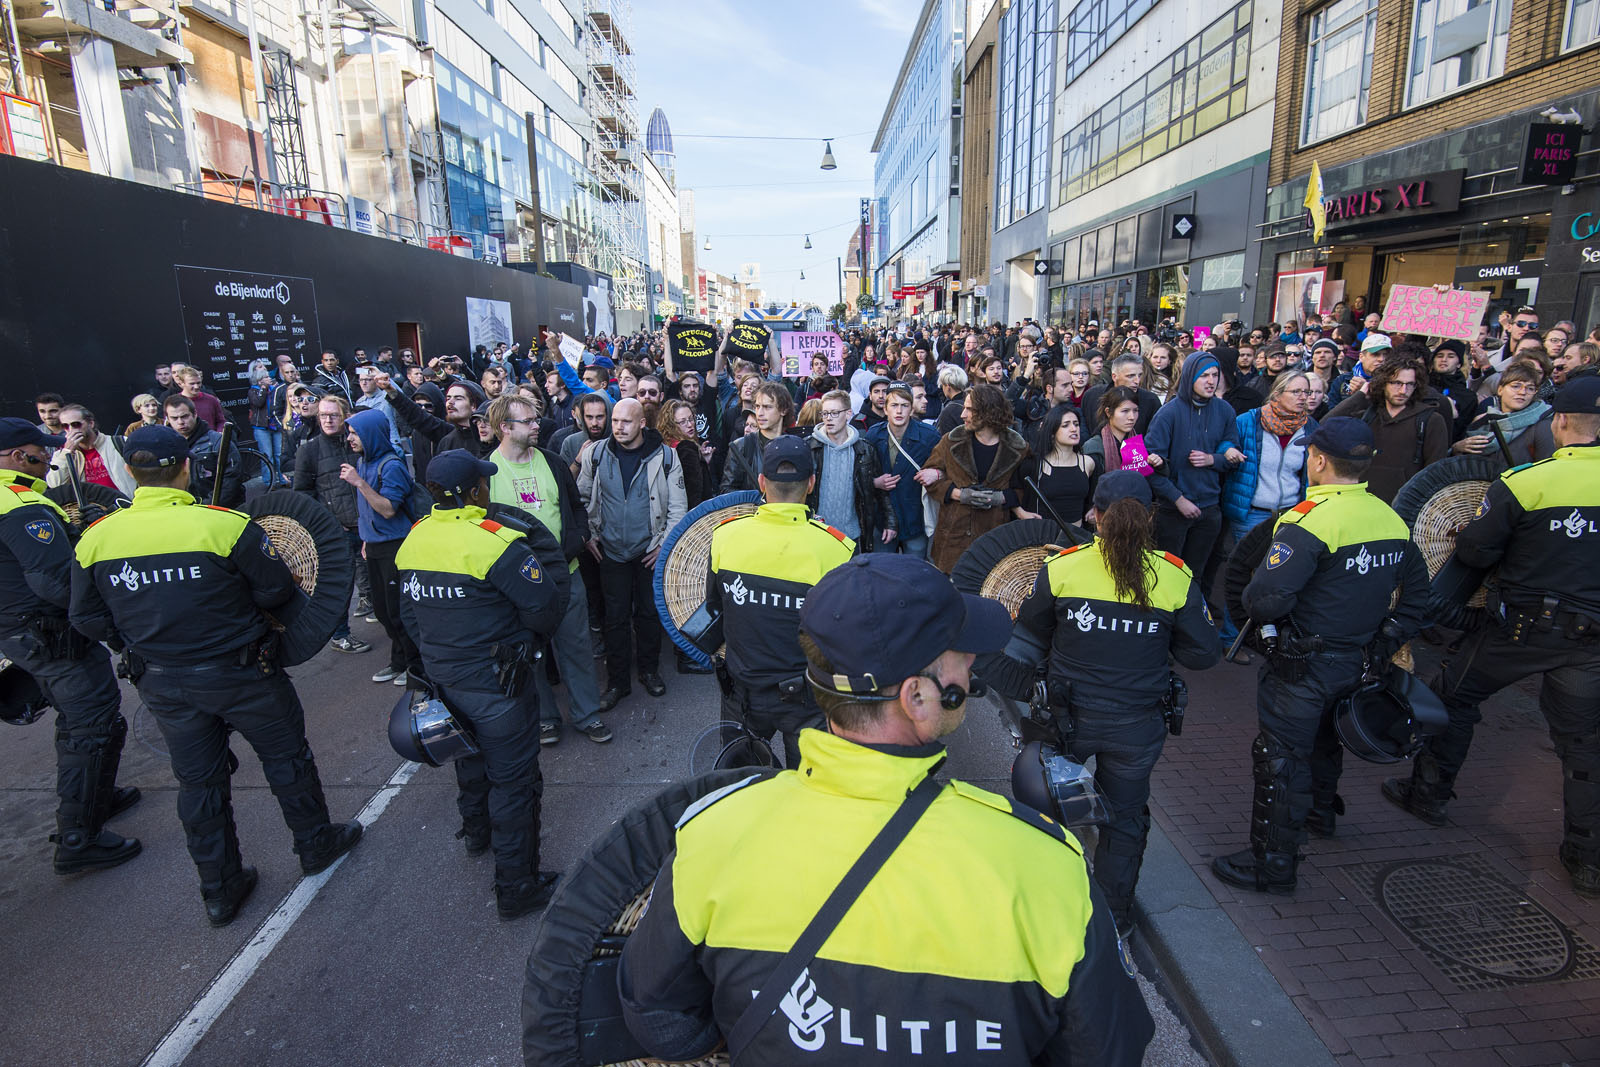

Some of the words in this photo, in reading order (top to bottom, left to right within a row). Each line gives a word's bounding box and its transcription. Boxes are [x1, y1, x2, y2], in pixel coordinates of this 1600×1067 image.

[1546, 133, 1565, 146] ICI
[1533, 147, 1571, 161] PARIS
[1542, 162, 1559, 176] XL
[1324, 188, 1384, 226] PARIS
[1394, 180, 1431, 210] XL
[1582, 247, 1600, 263] Se
[1478, 265, 1521, 278] CHANEL
[215, 281, 230, 296] de
[230, 282, 275, 300] Bijenkorf
[1386, 301, 1477, 323] FASCIST
[675, 329, 713, 339] REFUGEES
[1382, 315, 1475, 338] COWARDS
[729, 335, 764, 350] WELCOME
[791, 336, 795, 350] I
[799, 335, 836, 349] REFUSE
[678, 347, 714, 357] WELCOME
[802, 350, 815, 359] TO
[109, 560, 202, 591] POLITIE
[402, 572, 466, 602] POLITIE
[722, 574, 805, 609] POLITIE
[1066, 601, 1159, 632] POLITIE
[751, 967, 1002, 1055] OLITIE
